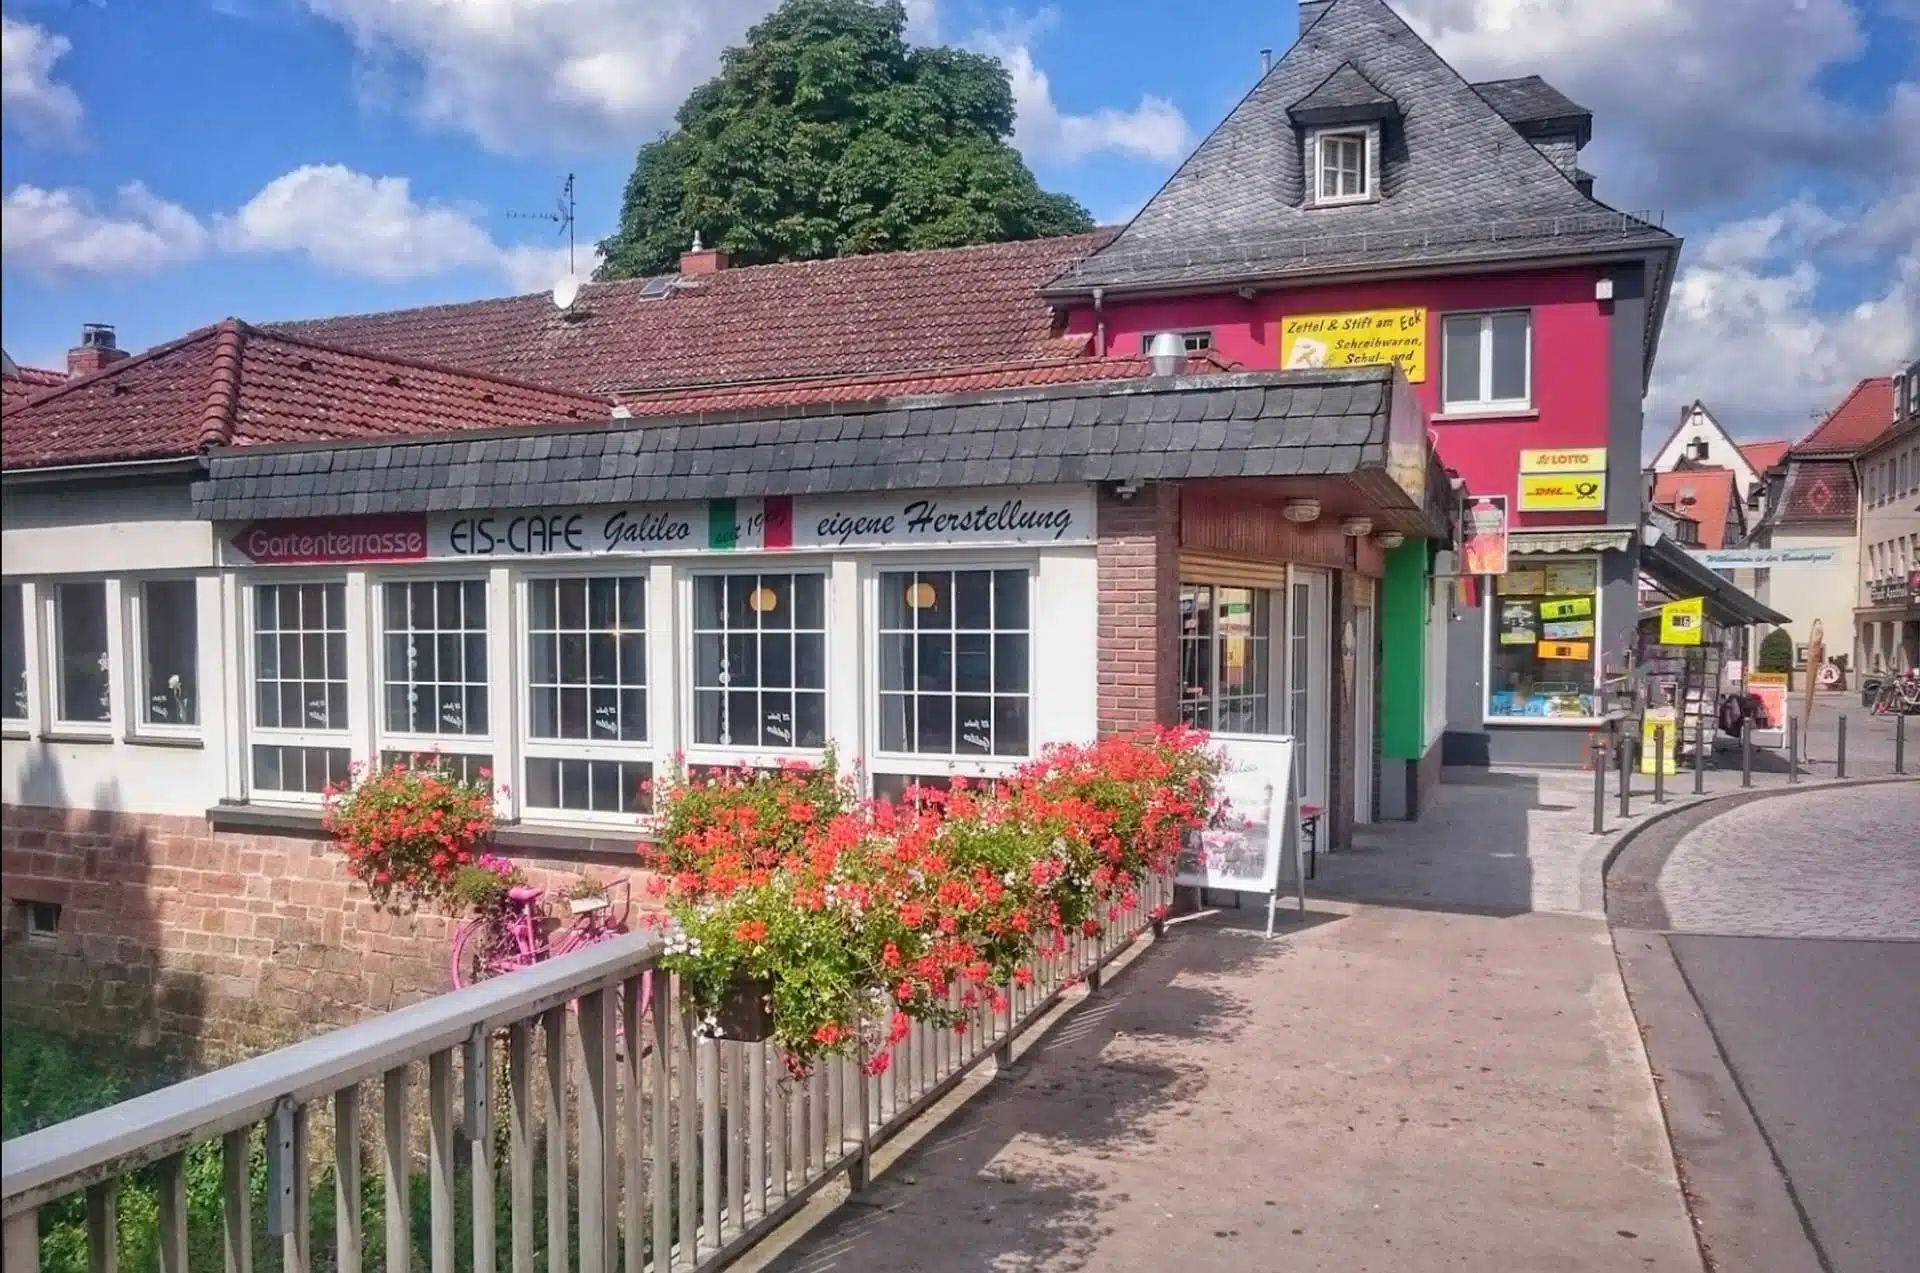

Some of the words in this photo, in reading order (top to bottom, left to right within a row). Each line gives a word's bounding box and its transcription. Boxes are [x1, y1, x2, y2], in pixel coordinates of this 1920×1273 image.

[1288, 319, 1325, 334] Zettel
[1327, 319, 1339, 332] &
[1342, 317, 1373, 331] Stift
[1376, 317, 1394, 329] am
[1400, 308, 1422, 332] Eck
[1334, 336, 1422, 351] Schreibwaren,
[1344, 351, 1385, 364] Schul-
[1390, 350, 1414, 362] und
[1551, 454, 1589, 465] LOTTO
[1535, 487, 1563, 496] DHL
[450, 514, 583, 554] EIS-CAFE
[603, 510, 691, 552] Galileo
[817, 511, 896, 546] eigene
[903, 499, 1073, 541] Herstellung
[249, 529, 423, 557] Gartenterrasse
